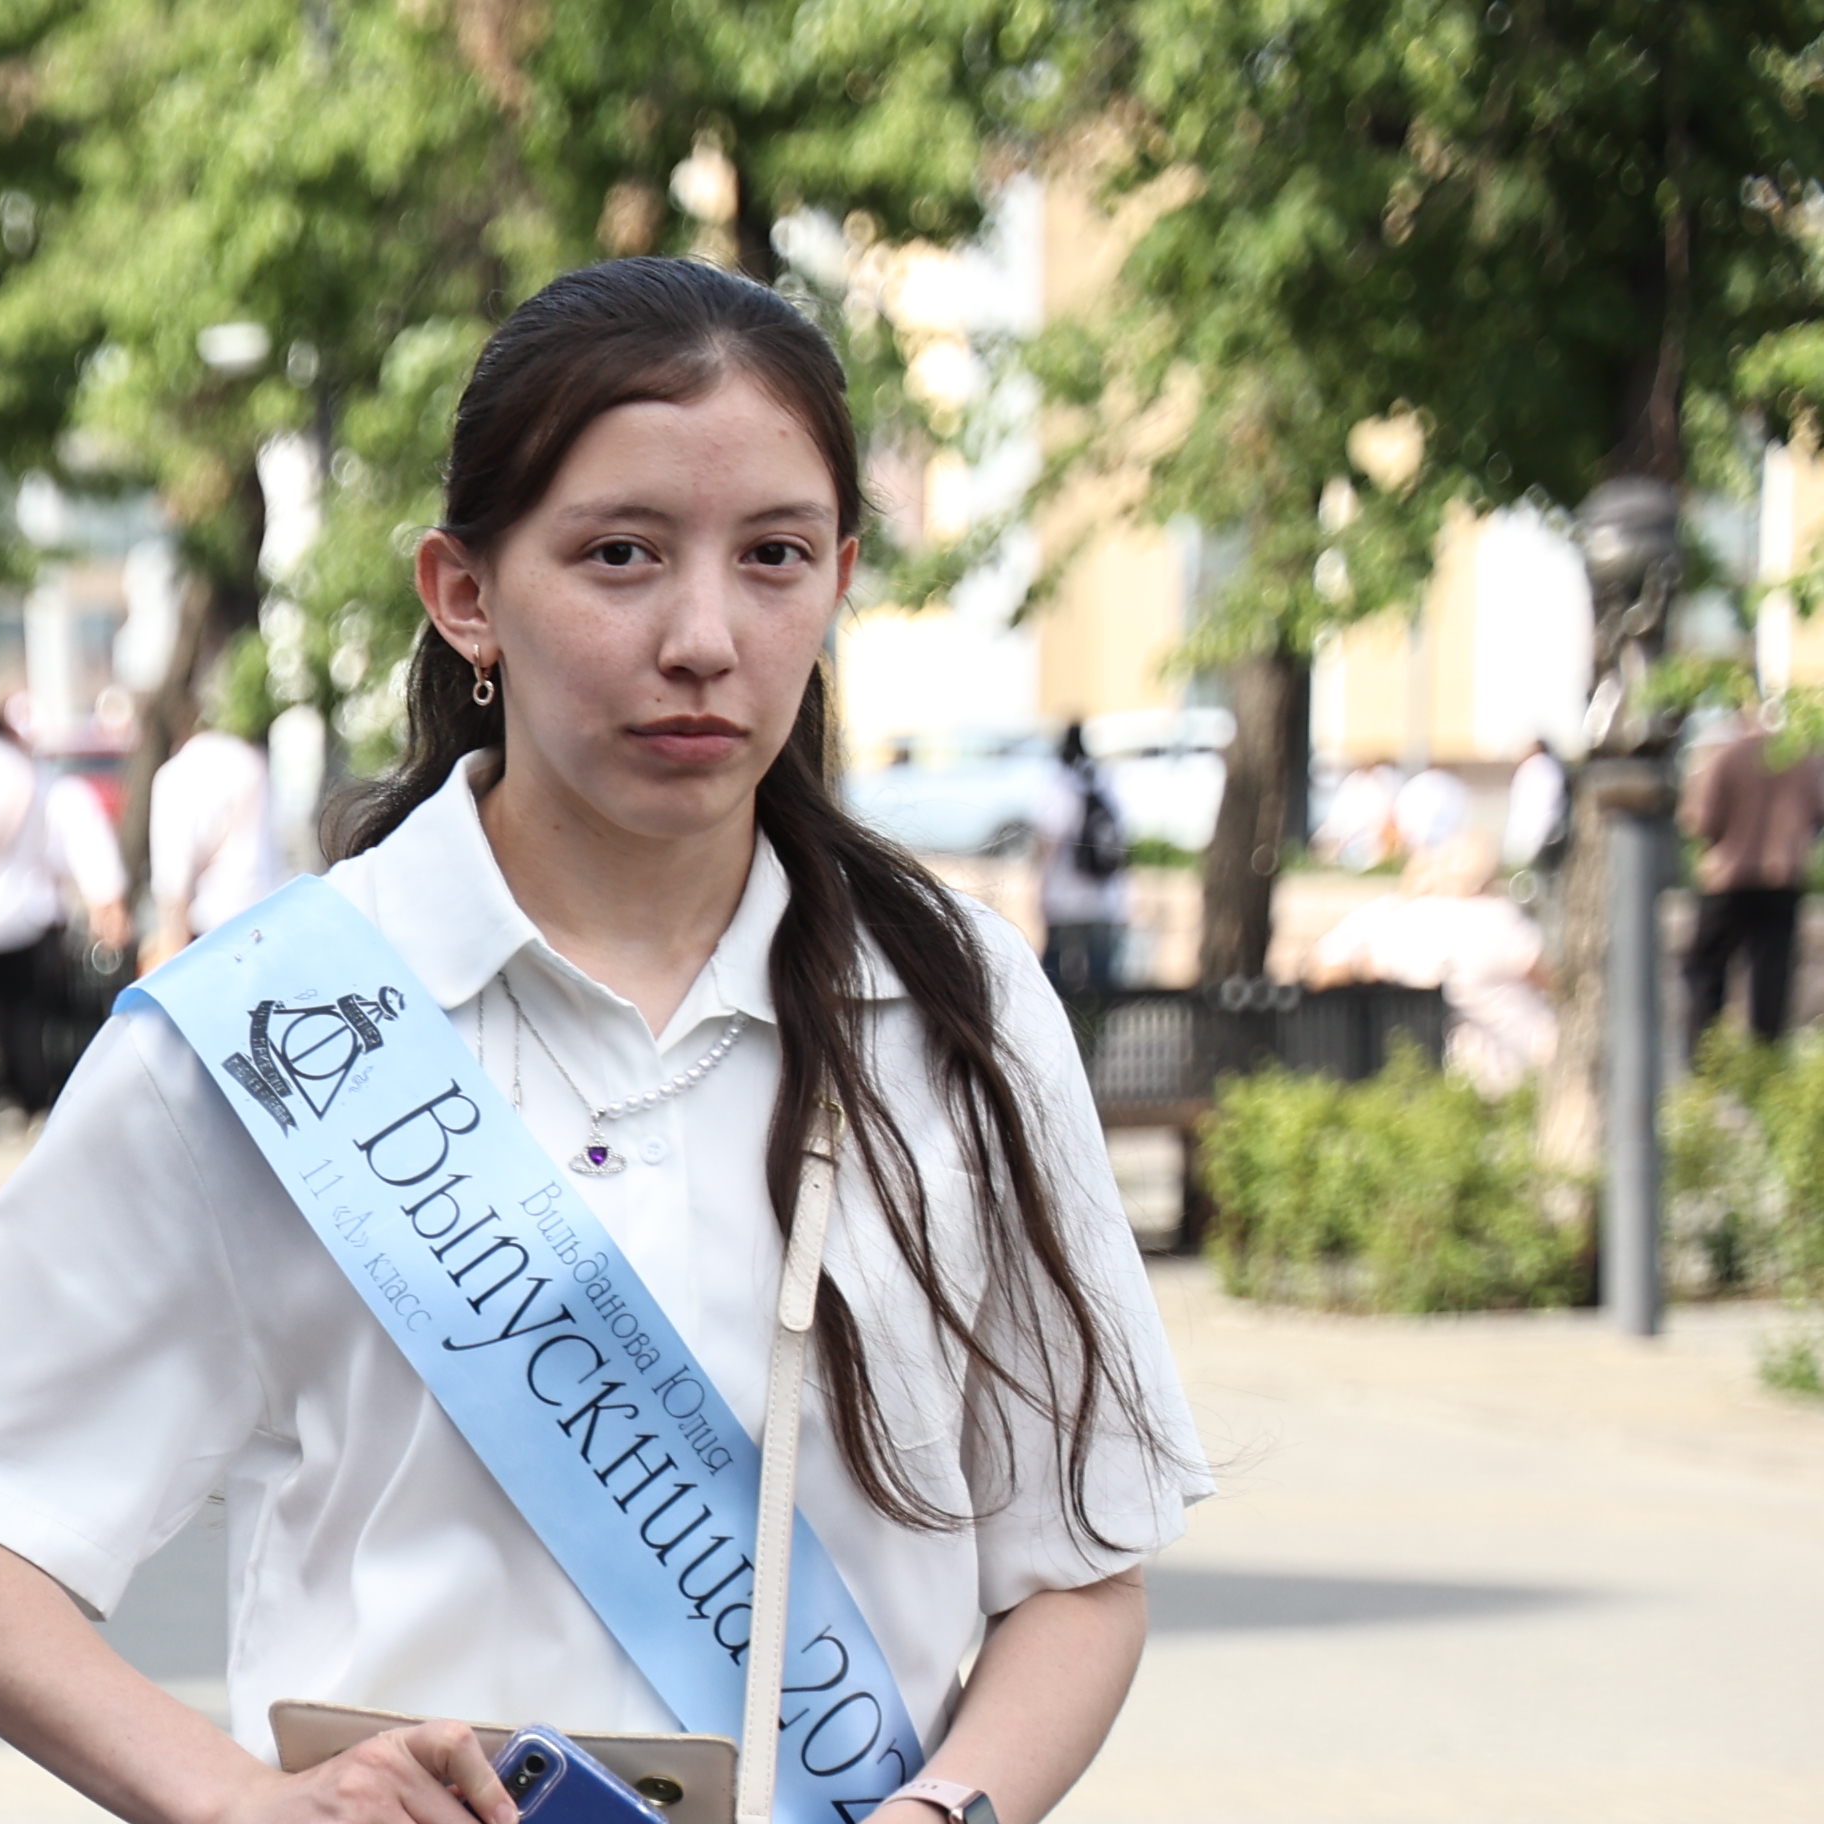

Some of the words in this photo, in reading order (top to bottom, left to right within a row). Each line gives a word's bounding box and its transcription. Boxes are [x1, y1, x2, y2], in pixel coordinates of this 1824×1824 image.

[298, 1158, 344, 1200] 11
[362, 1252, 433, 1333] класс
[353, 1078, 756, 1666] Выпускница
[517, 1180, 661, 1376] Вильданова
[651, 1363, 737, 1478] Юлия
